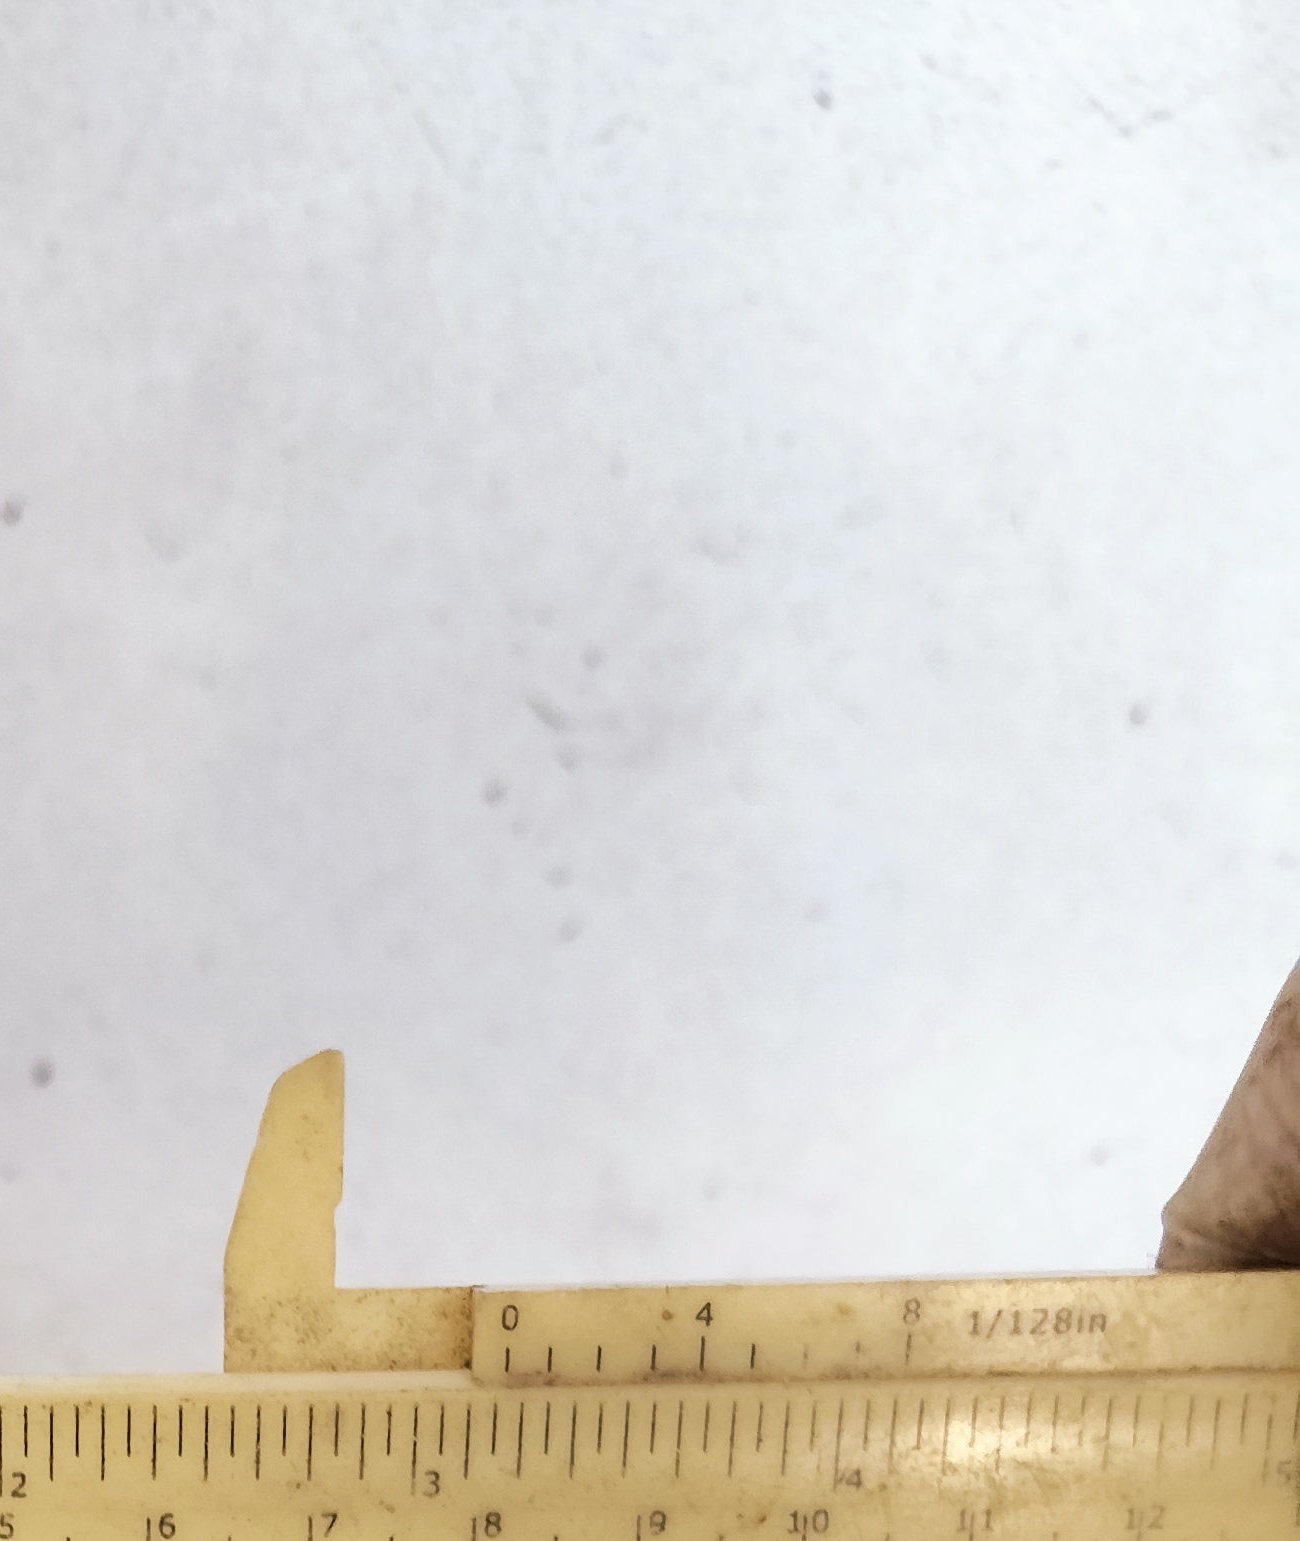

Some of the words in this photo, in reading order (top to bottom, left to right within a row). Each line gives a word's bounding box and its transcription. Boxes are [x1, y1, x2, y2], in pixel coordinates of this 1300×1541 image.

[502, 1304, 519, 1331] 0
[695, 1302, 714, 1327] 4
[902, 1298, 921, 1325] 8
[967, 1308, 1109, 1337] 1/128in
[10, 1472, 27, 1498] 2
[424, 1471, 440, 1497] 3
[845, 1468, 863, 1490] 4
[0, 1514, 15, 1540] 5
[158, 1513, 176, 1539] 6
[322, 1513, 338, 1538] 7
[484, 1512, 502, 1538] 8
[649, 1511, 667, 1535] 9
[786, 1510, 830, 1535] 10
